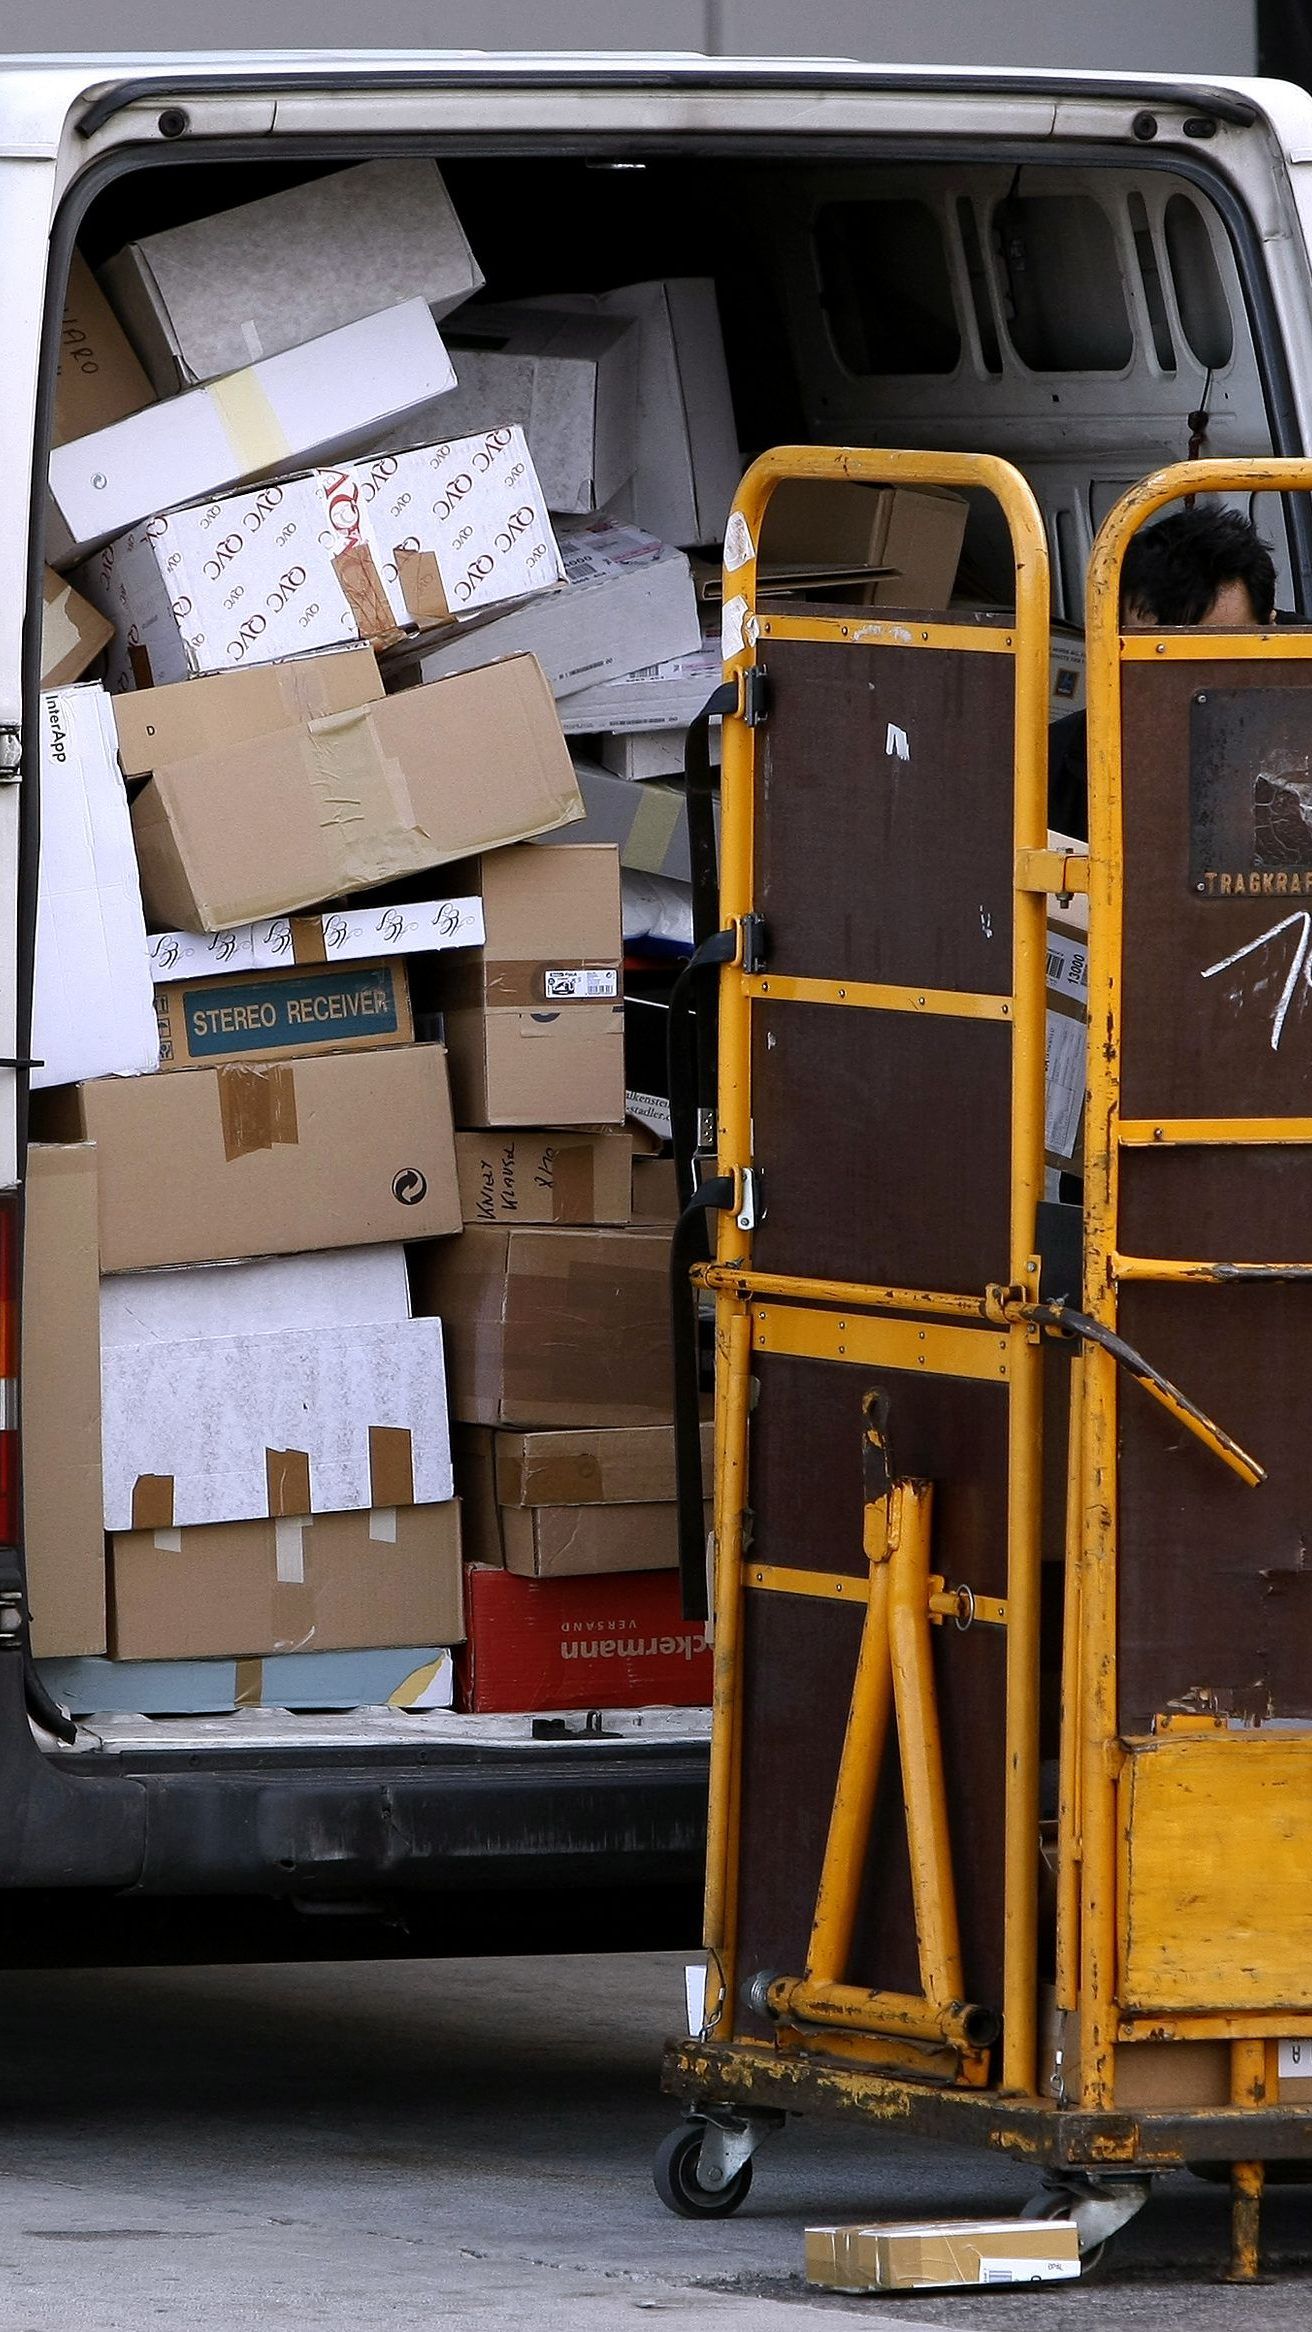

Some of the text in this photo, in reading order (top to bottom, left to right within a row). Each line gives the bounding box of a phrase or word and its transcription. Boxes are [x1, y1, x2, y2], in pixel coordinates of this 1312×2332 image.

[430, 445, 451, 469] QVC
[472, 428, 512, 473] QVC
[360, 456, 398, 503] QVC
[504, 462, 525, 487] QVC
[243, 485, 283, 533] QVC
[390, 492, 412, 517] QVC
[432, 473, 473, 521] QVC
[200, 505, 221, 529] QVC
[494, 506, 534, 553] QVC
[275, 522, 297, 547] QVC
[452, 525, 473, 550] QVC
[203, 533, 243, 580] QVC
[526, 543, 547, 568] QVC
[266, 566, 306, 613] QVC
[454, 554, 494, 602] QVC
[223, 585, 245, 610] QVC
[299, 603, 320, 627] QVC
[226, 614, 267, 661] QVC
[46, 695, 67, 763] InterApp
[146, 725, 155, 736] D
[1067, 953, 1085, 985] 13000
[193, 990, 389, 1036] STEREO RECEIVER
[561, 1619, 637, 1632] VERSAND
[561, 1634, 715, 1660] ckermann
